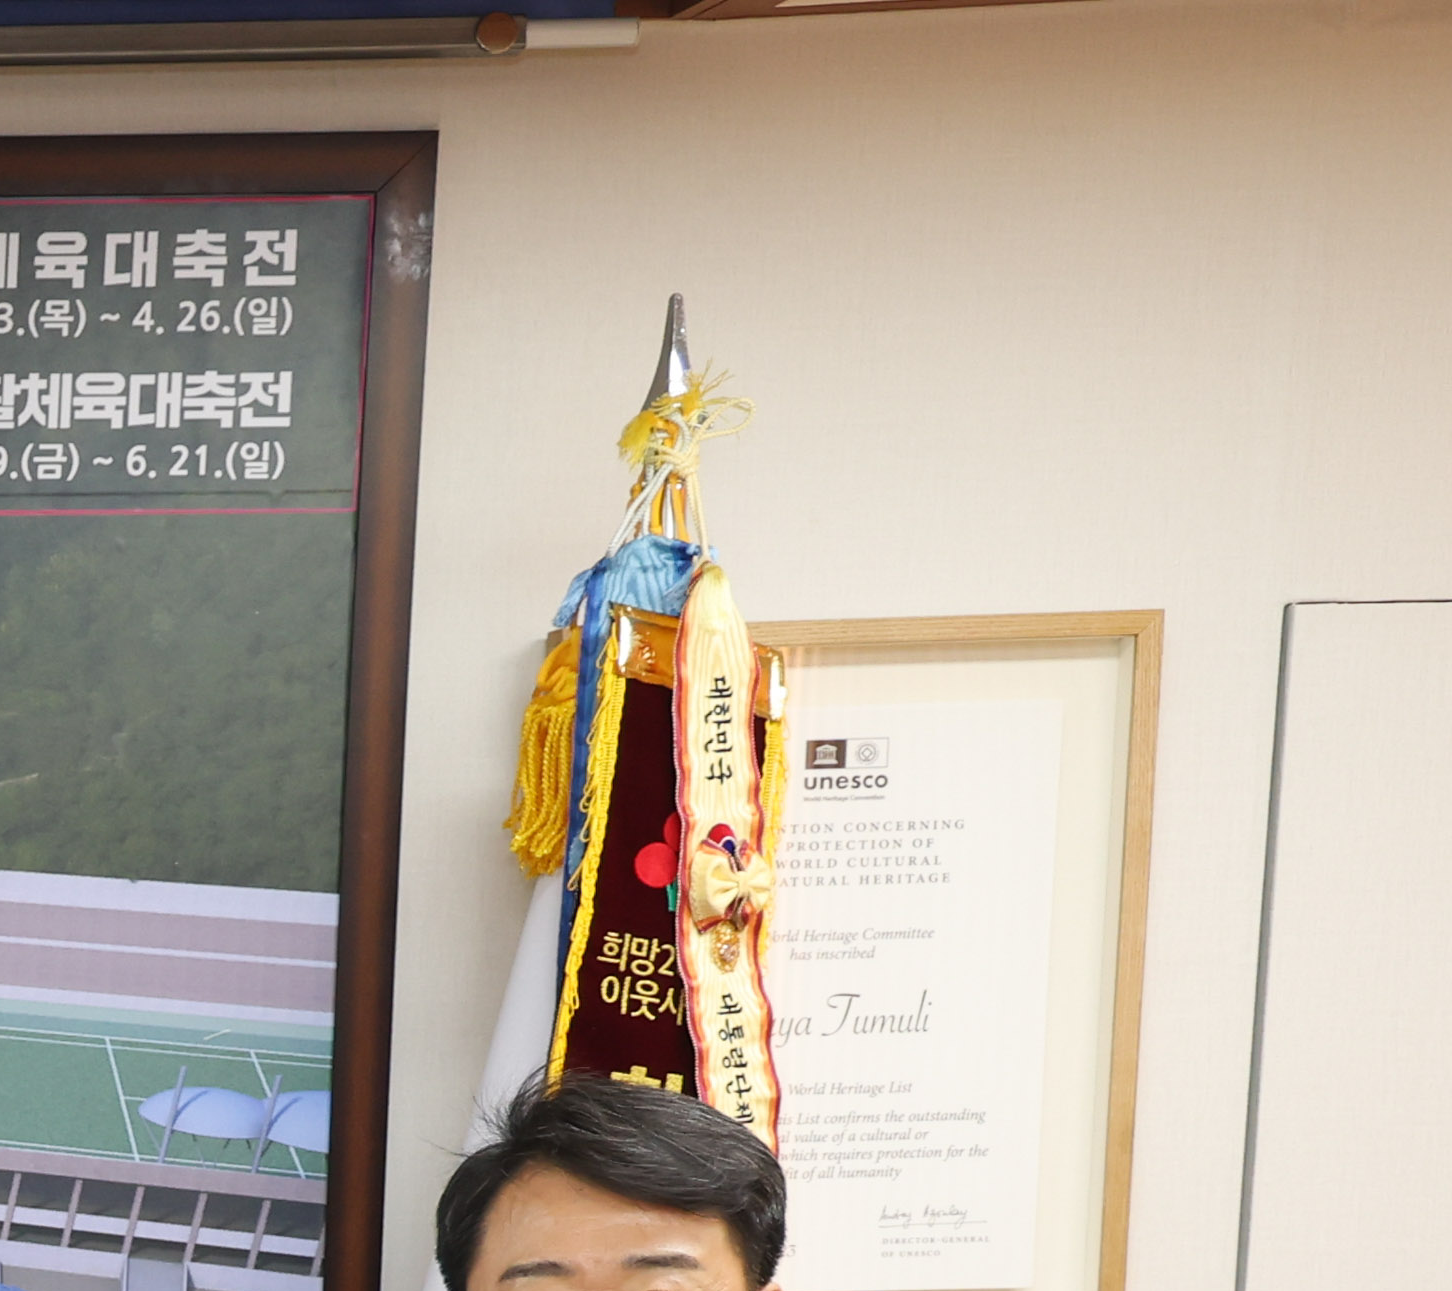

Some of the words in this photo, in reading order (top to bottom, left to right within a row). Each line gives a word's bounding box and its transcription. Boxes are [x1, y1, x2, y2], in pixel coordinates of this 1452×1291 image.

[132, 302, 164, 335] 4.
[177, 297, 292, 337] 26.(일)
[125, 446, 158, 478] 6.
[169, 441, 286, 482] 21.(일)
[703, 676, 734, 786] 대한민국
[804, 775, 888, 790] unesco
[778, 823, 834, 835] NTION
[844, 819, 965, 833] CONCERNING
[786, 838, 903, 851] PROTECTION
[912, 837, 935, 848] OF
[776, 857, 838, 869] WORLD
[847, 855, 942, 868] CULTURAL
[775, 876, 849, 888] ATURAL
[859, 872, 951, 886] HERITAGE
[772, 929, 799, 943] orld
[803, 929, 858, 945] Heritage
[862, 927, 935, 941] Committee
[597, 932, 676, 977] 희망2
[789, 948, 812, 961] has
[816, 946, 876, 961] inscribed
[600, 975, 686, 1026] 이웃사
[770, 1015, 812, 1048] ya
[821, 989, 933, 1036] Tumuli
[788, 1083, 827, 1096] World
[830, 1081, 885, 1098] Heritage
[889, 1081, 913, 1095] List
[797, 1113, 820, 1125] List
[824, 1110, 880, 1126] confirms
[885, 1110, 904, 1123] the
[908, 1108, 986, 1124] outstanding
[794, 1131, 828, 1143] value
[831, 1129, 845, 1146] of
[848, 1132, 856, 1142] a
[860, 1128, 911, 1142] cultural
[914, 1131, 929, 1141] or
[779, 1149, 818, 1162] which
[822, 1150, 873, 1164] requires
[876, 1147, 943, 1165] protection
[946, 1146, 966, 1162] for
[969, 1146, 989, 1158] the
[802, 1166, 814, 1182] of
[817, 1167, 834, 1179] all
[837, 1167, 902, 1182] humanity
